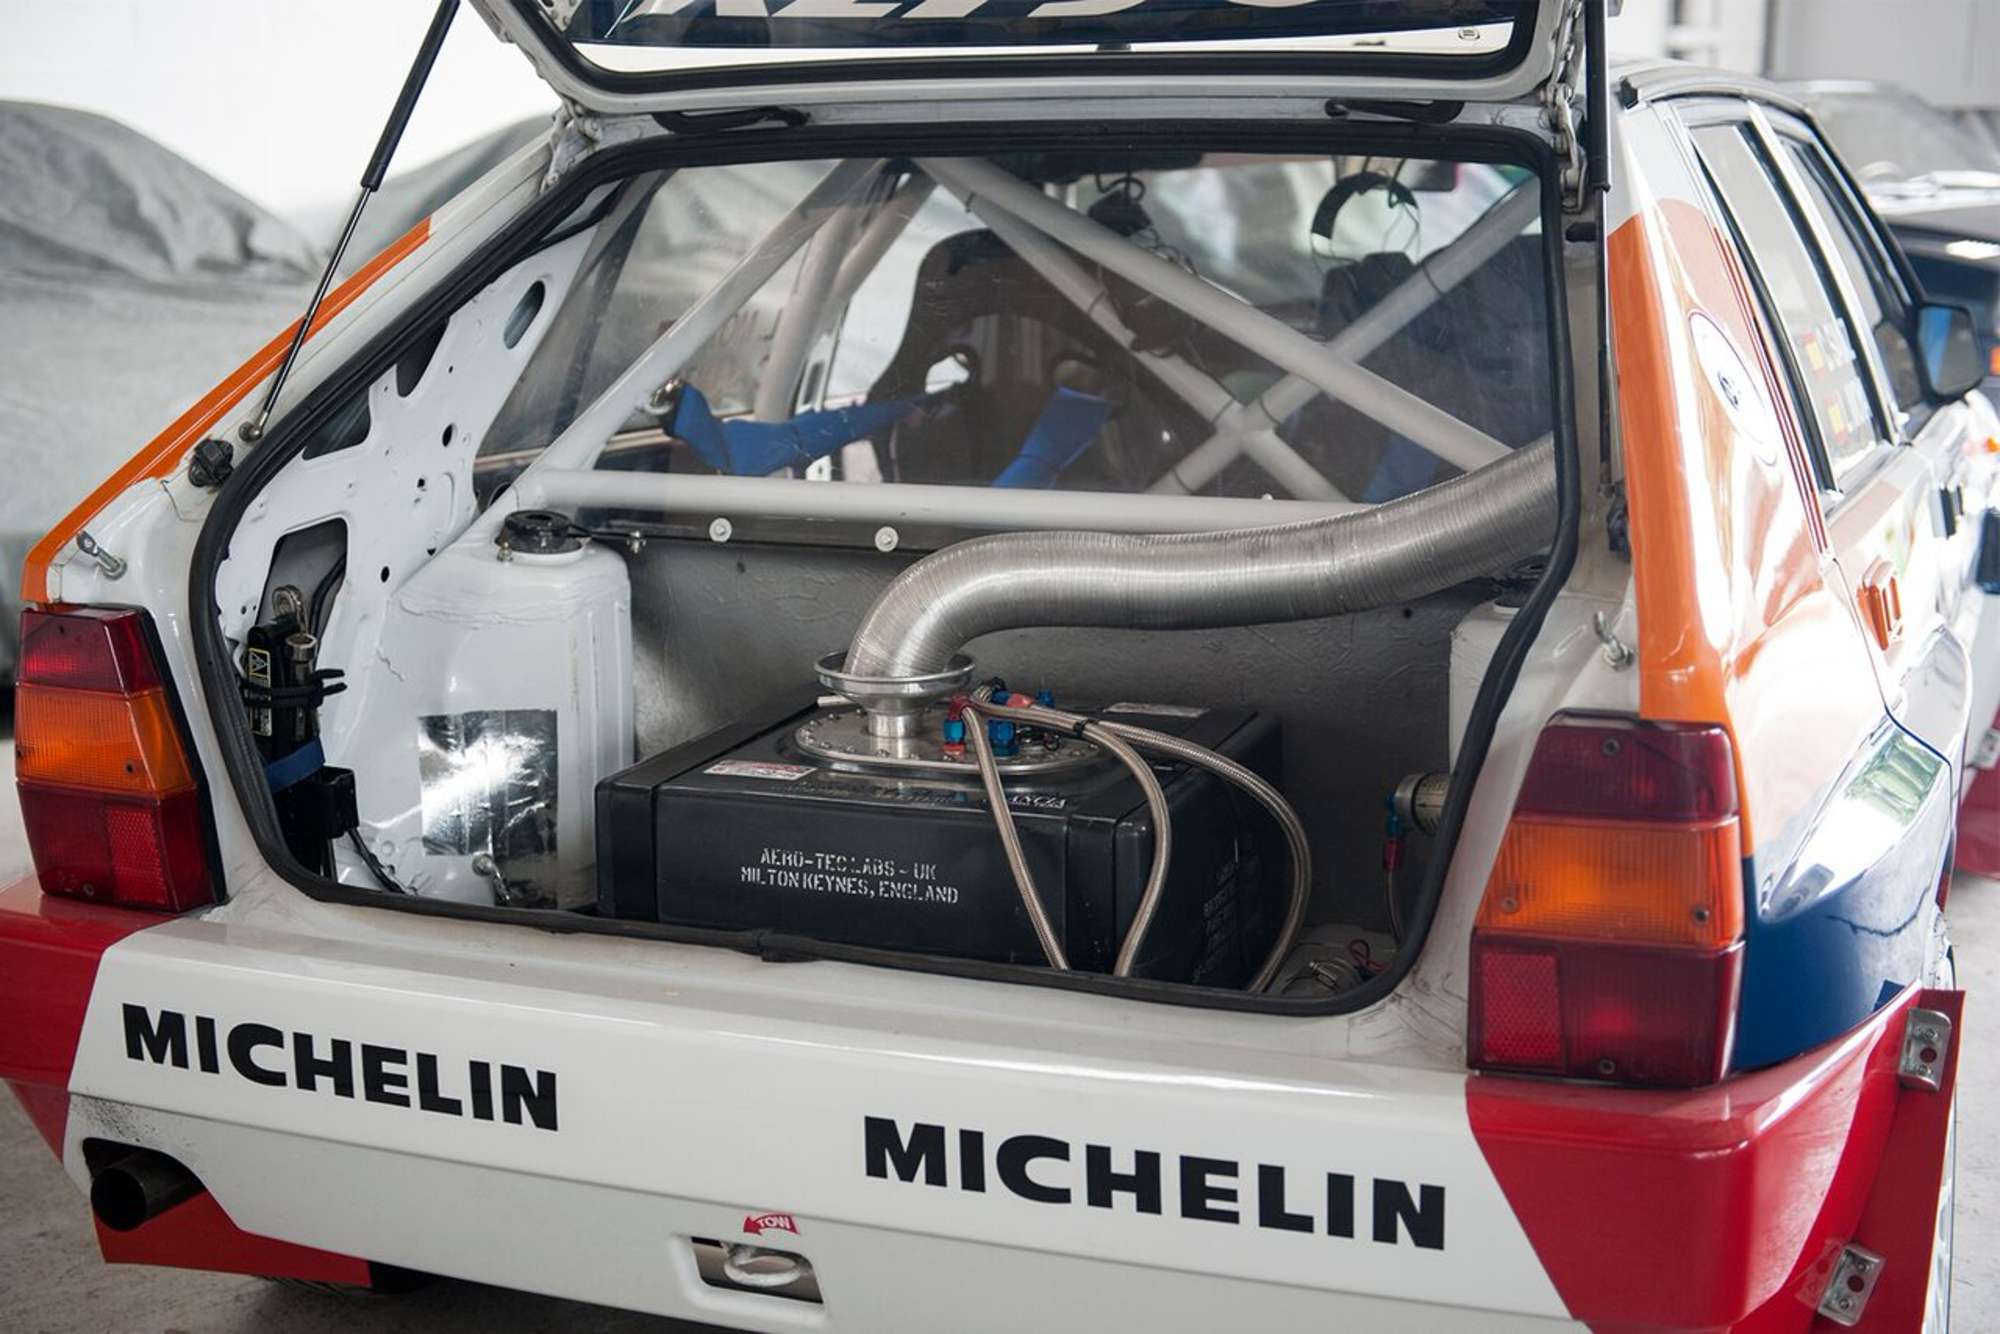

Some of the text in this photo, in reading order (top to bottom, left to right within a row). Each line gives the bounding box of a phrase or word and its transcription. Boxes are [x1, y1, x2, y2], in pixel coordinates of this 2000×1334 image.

[741, 866, 799, 888] MILTON
[879, 880, 959, 903] ENGLAND
[913, 863, 936, 881] UK
[122, 1003, 558, 1131] MICHELIN
[864, 1116, 1446, 1251] MICHELIN
[755, 1215, 791, 1229] TOW
